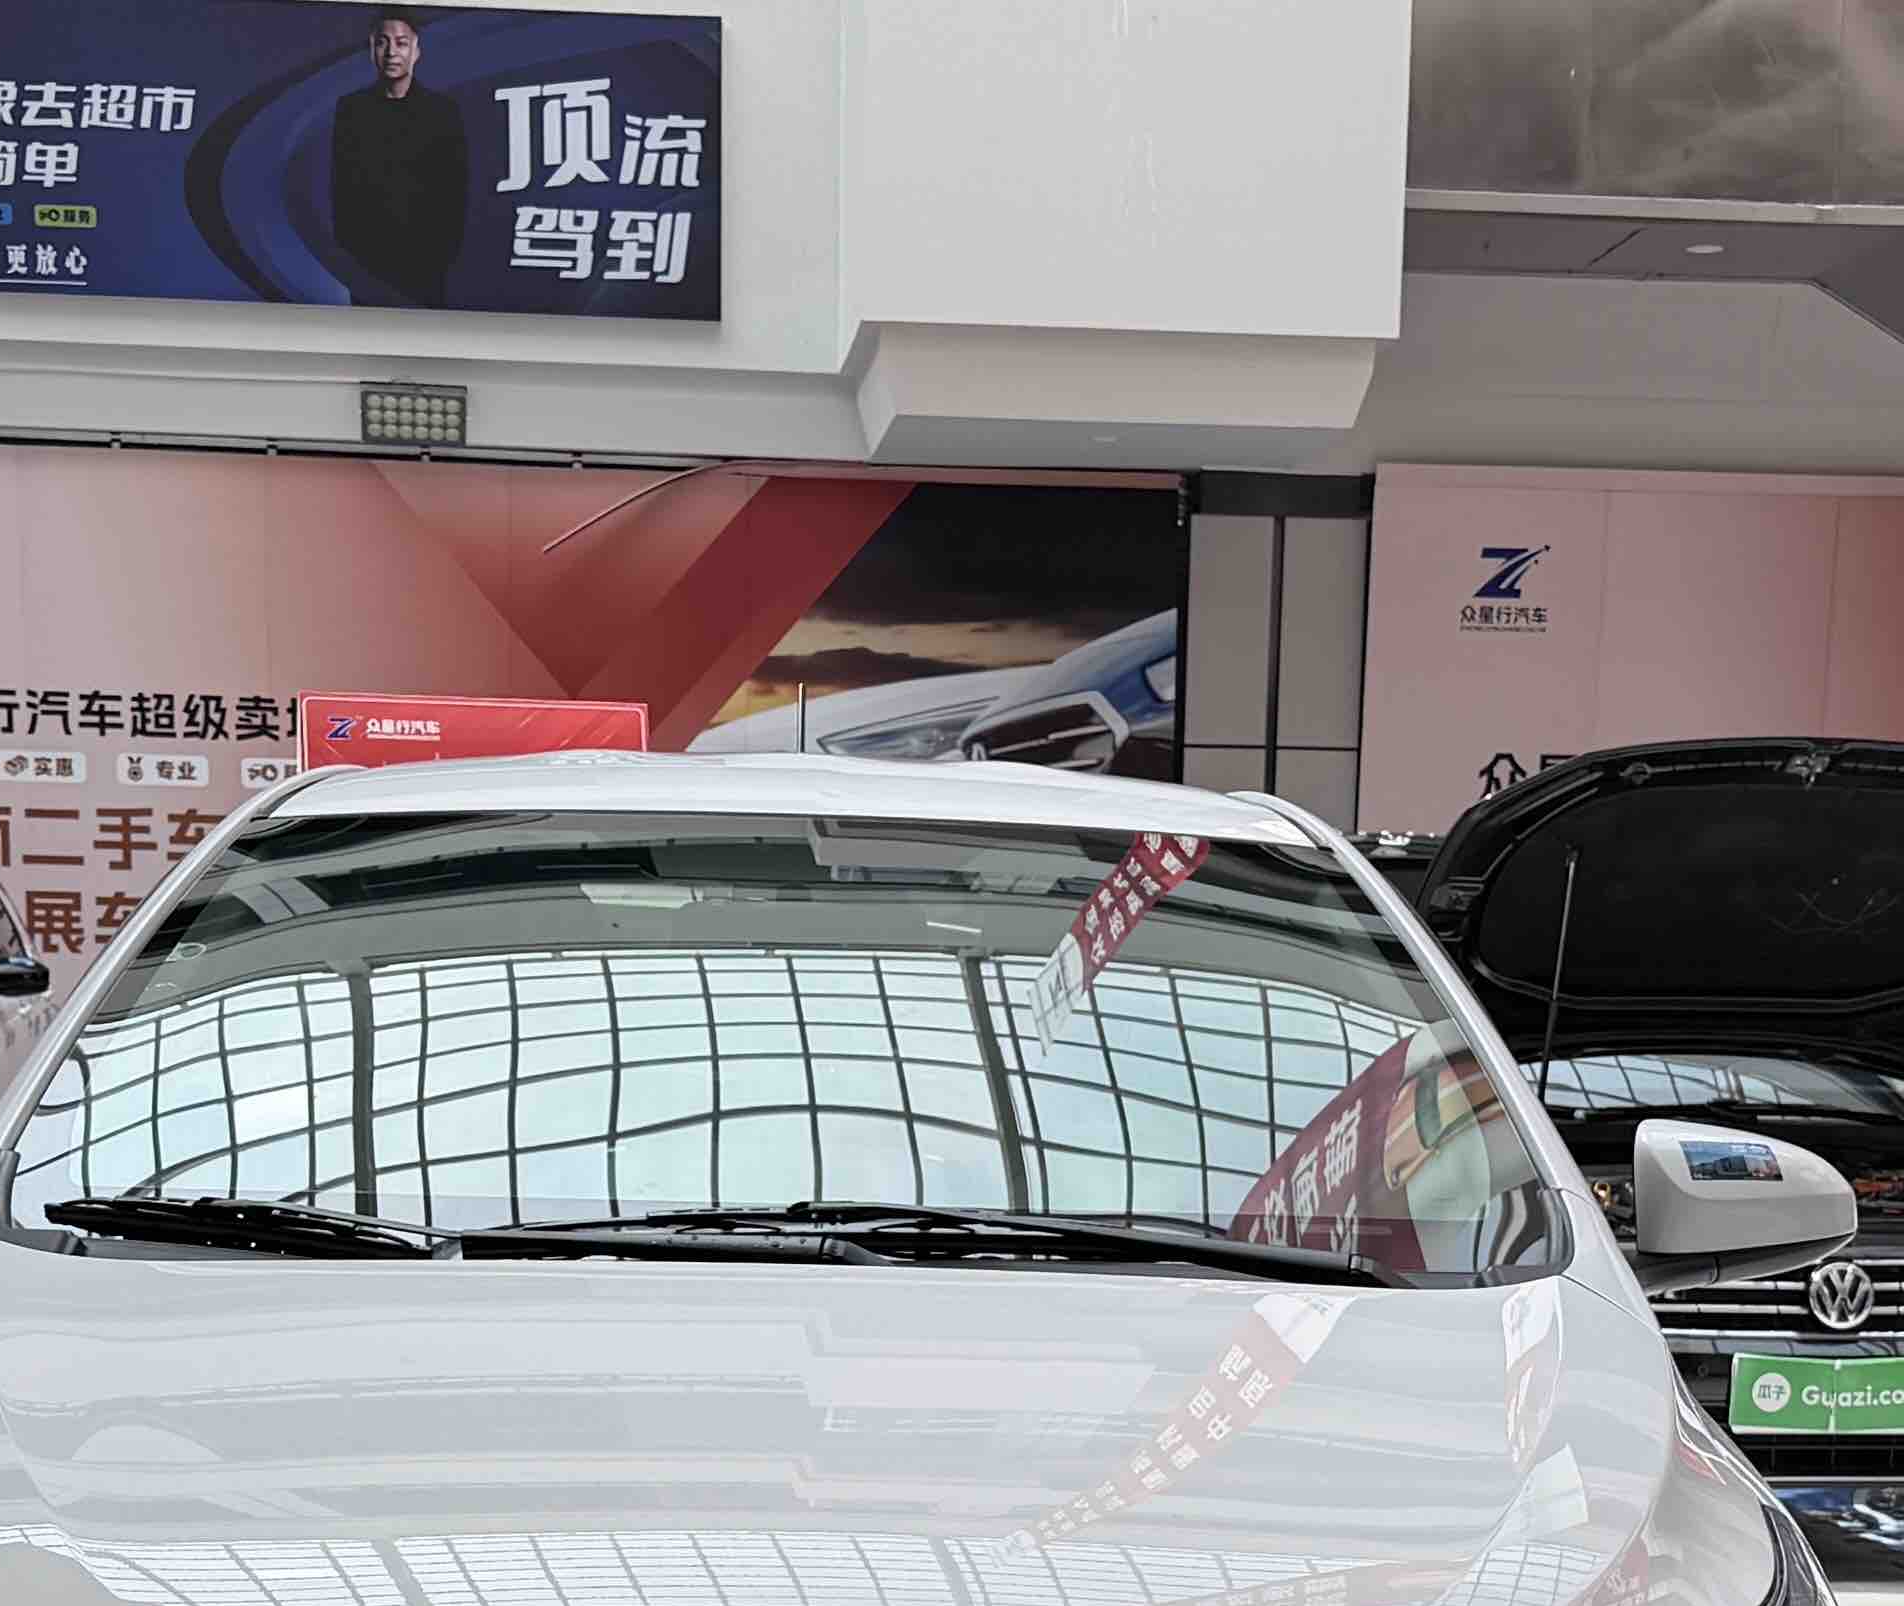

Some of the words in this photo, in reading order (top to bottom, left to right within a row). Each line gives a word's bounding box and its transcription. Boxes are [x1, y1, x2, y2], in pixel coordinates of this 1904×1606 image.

[495, 76, 704, 193] 顶流
[509, 206, 692, 285] 驾到
[1460, 605, 1548, 624] 众星行汽车
[34, 756, 74, 777] 实惠
[156, 761, 197, 781] 专业
